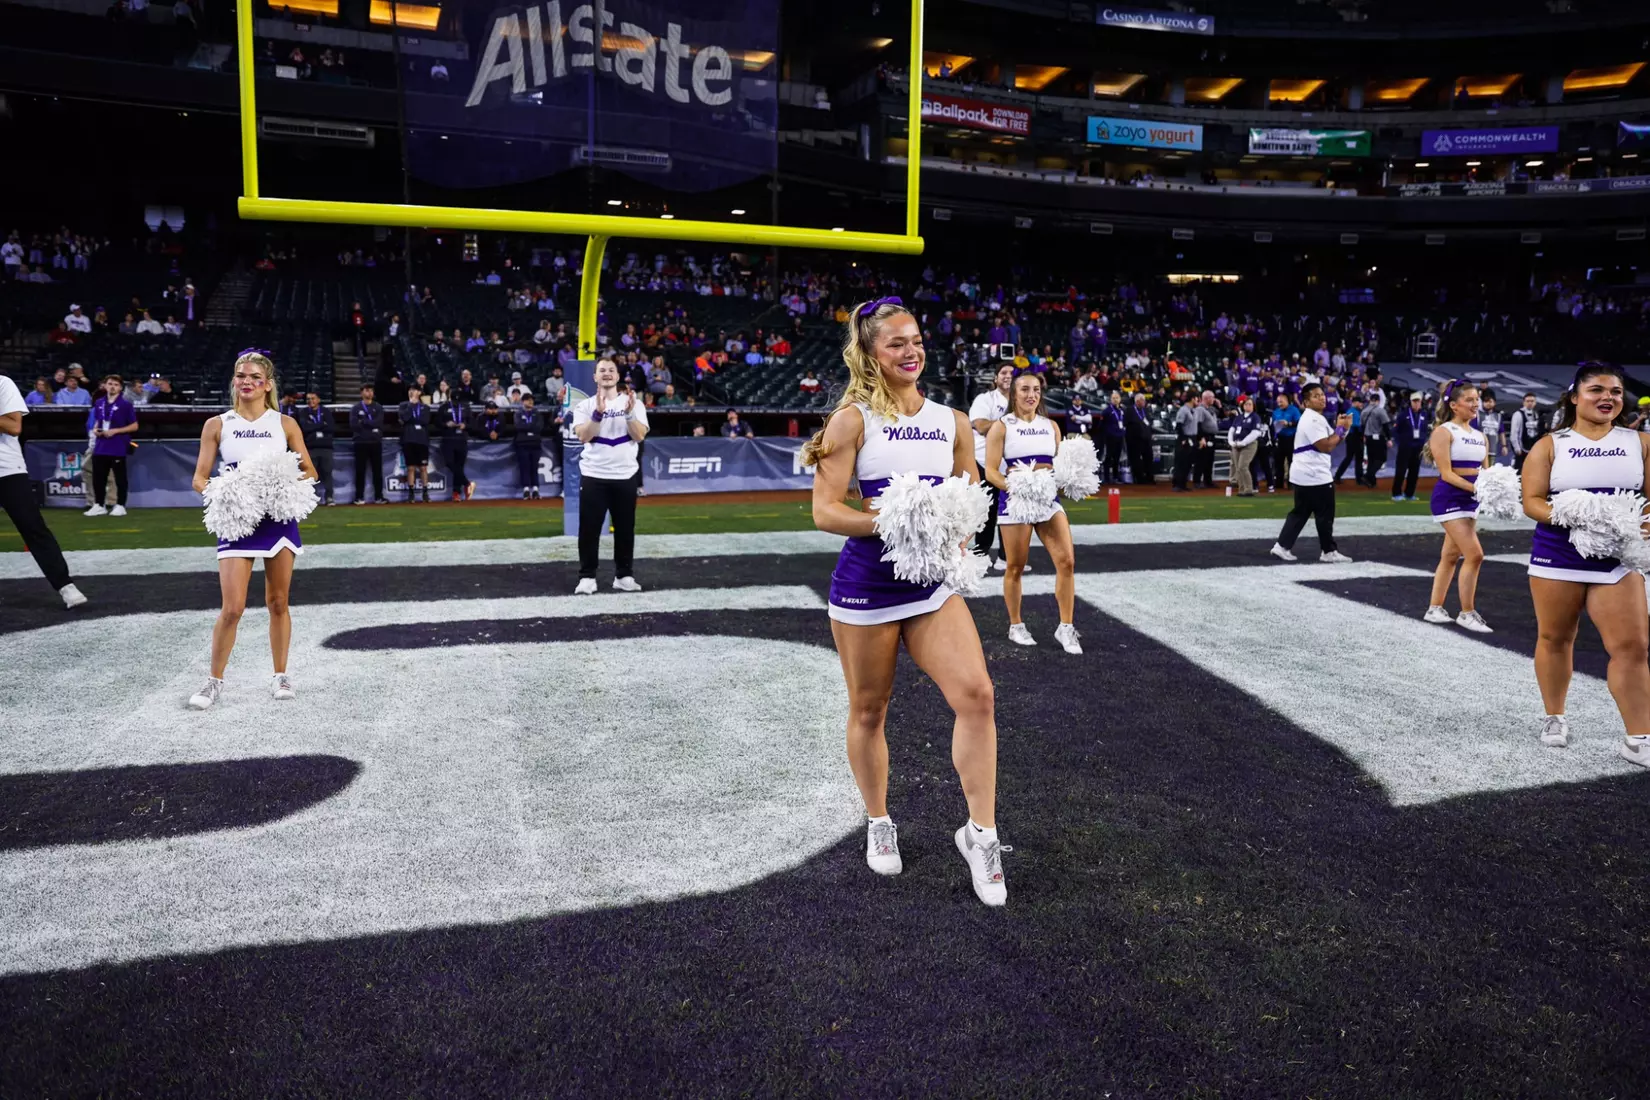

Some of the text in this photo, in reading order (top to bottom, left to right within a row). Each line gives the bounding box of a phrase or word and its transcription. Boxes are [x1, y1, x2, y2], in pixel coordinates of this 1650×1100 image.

[1103, 8, 1195, 30] CASINO ARIZONA
[465, 0, 733, 107] Allstate
[933, 102, 989, 123] Ballpark
[992, 107, 1029, 121] DOWNLOAD
[1009, 119, 1028, 131] FREE
[1113, 125, 1195, 145] zoyo yogurt
[1454, 132, 1547, 144] COMMONWEALTH
[233, 429, 272, 439] Wildcats
[883, 426, 948, 442] Wildcats
[1017, 428, 1050, 436] Wildcats
[1568, 447, 1628, 459] Wildcats
[668, 456, 722, 474] ESPN
